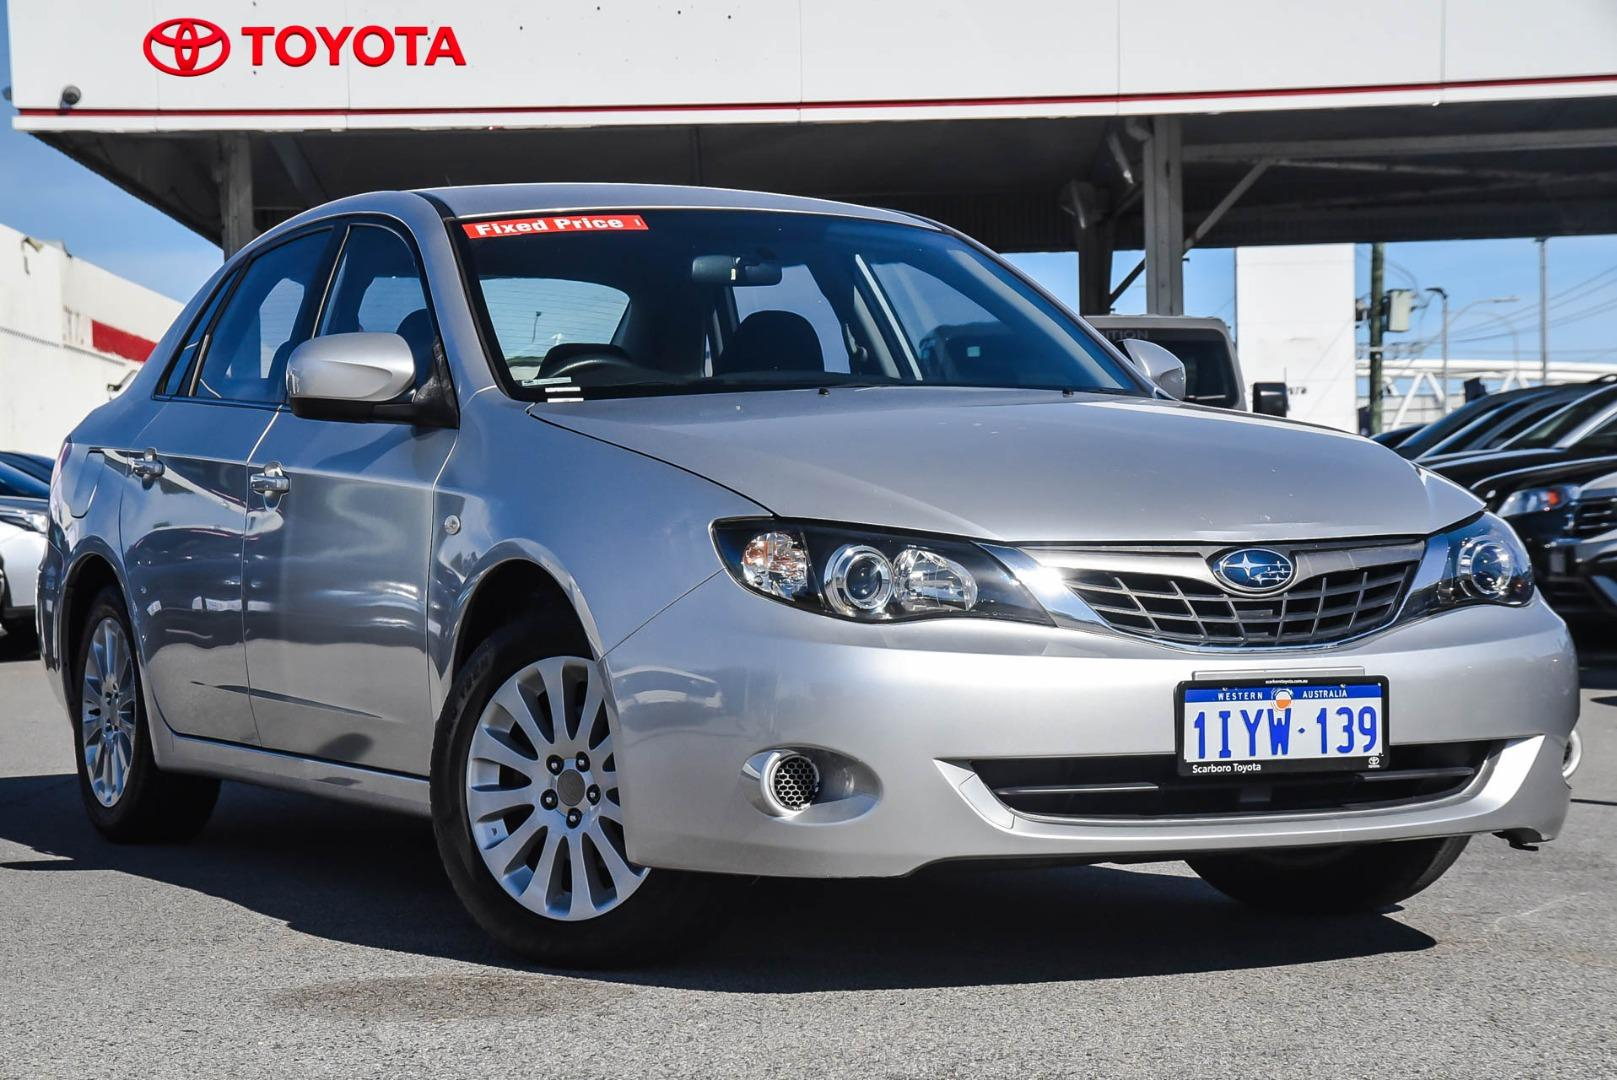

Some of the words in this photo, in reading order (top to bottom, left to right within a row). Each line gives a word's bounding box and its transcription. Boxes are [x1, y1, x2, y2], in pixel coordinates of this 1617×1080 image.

[241, 25, 467, 67] TOYOTA
[475, 219, 549, 236] Fixed
[554, 216, 624, 230] Price
[1218, 691, 1264, 701] WESTERN
[1302, 689, 1348, 699] AUSTRALIA
[1192, 765, 1231, 774] Scarboro
[1233, 763, 1262, 774] Toyota
